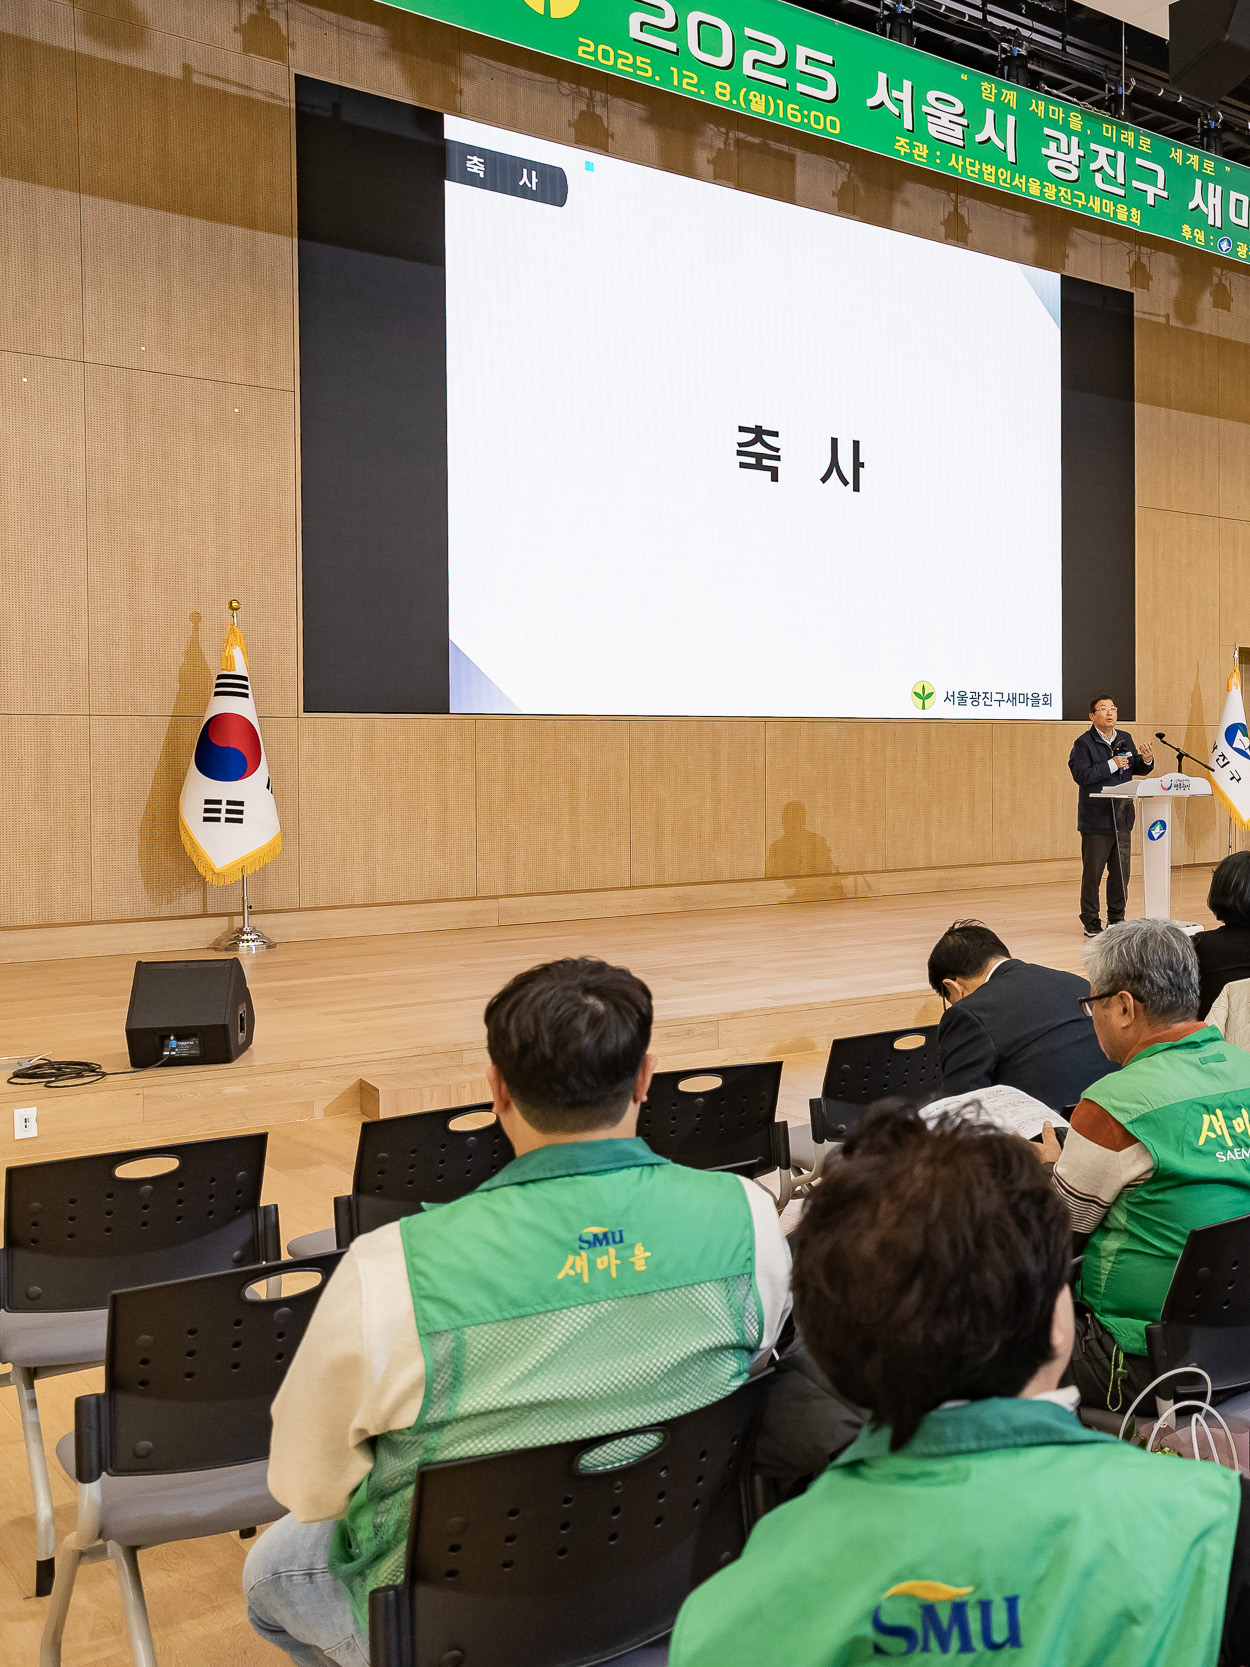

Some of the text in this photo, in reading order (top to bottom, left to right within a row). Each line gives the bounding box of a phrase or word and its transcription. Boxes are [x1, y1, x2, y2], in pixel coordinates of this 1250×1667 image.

[577, 37, 660, 82] 2025.
[670, 66, 705, 95] 12.
[629, 0, 838, 103] 2025
[866, 70, 1019, 165] 서울시
[1041, 126, 1170, 208] 광진구
[980, 80, 1017, 110] 함께
[1102, 123, 1152, 154] 미래로
[1169, 147, 1216, 176] 세계로
[465, 154, 539, 191] 축 사
[894, 136, 929, 164] 주관
[948, 153, 1141, 227] 사단법인서울광진구새마을회
[1181, 223, 1205, 246] 후원
[736, 424, 865, 493] 축 사
[943, 690, 1053, 708] 서울광진구새마을회
[556, 1242, 652, 1284] 새마을
[578, 1229, 625, 1250] SMU
[872, 1594, 1024, 1657] SMU
